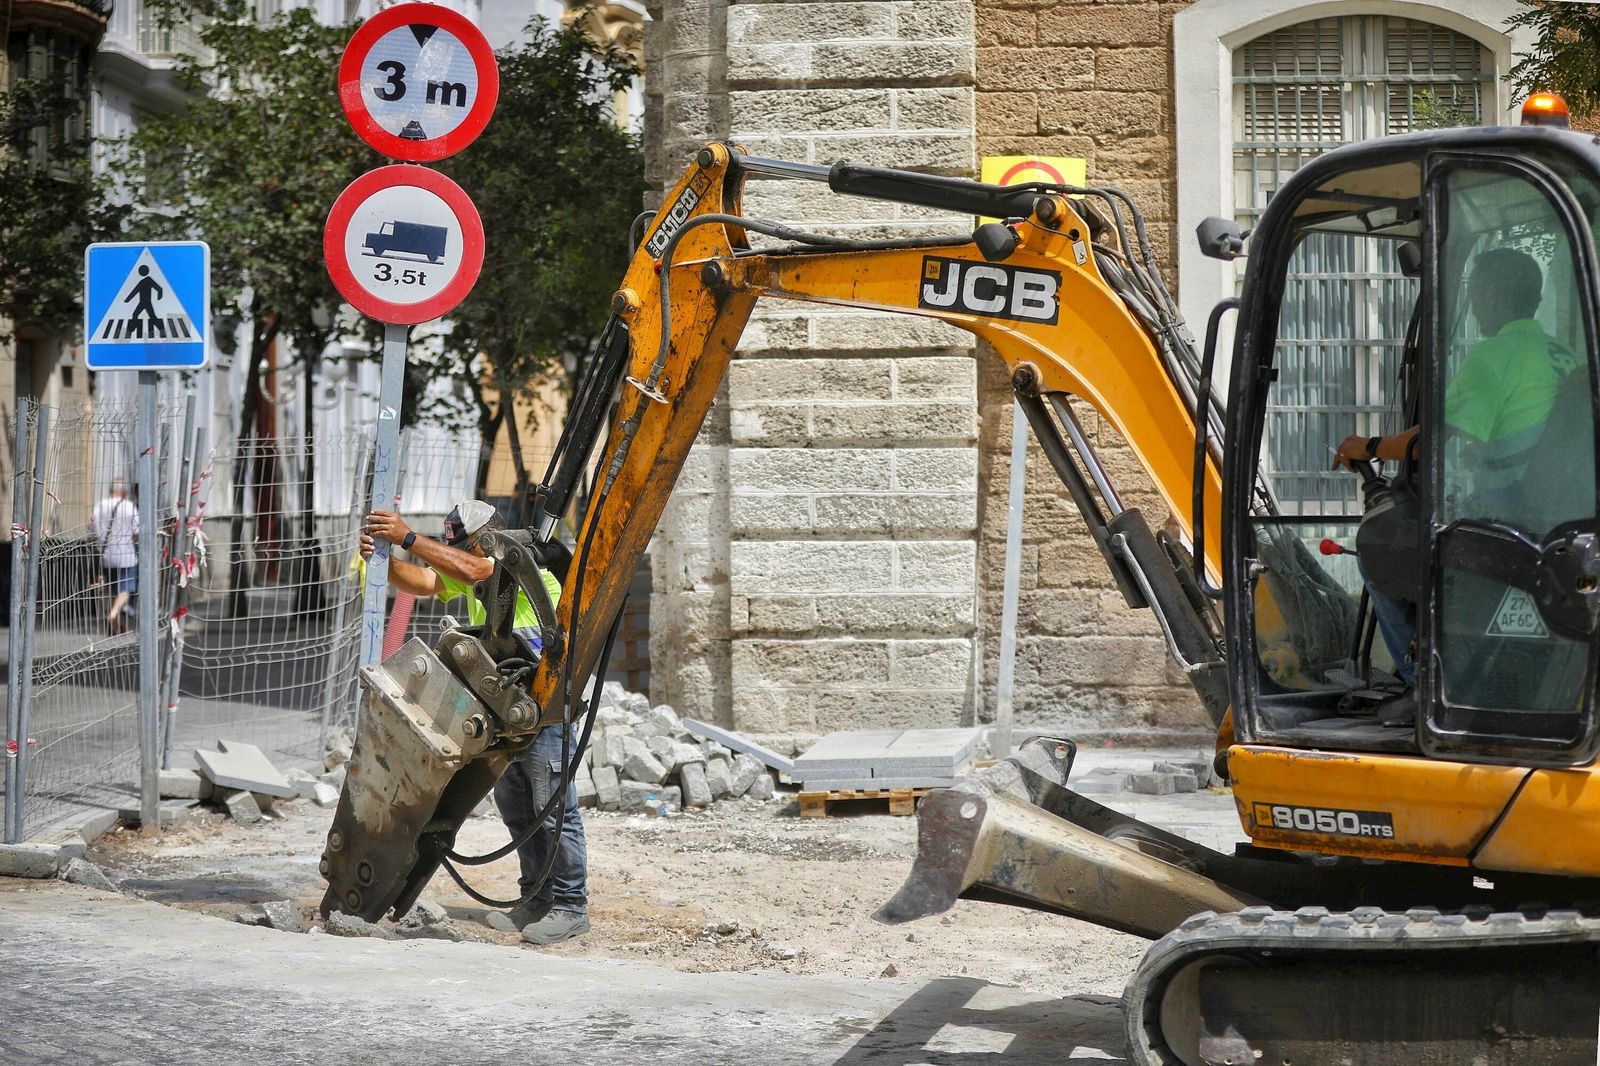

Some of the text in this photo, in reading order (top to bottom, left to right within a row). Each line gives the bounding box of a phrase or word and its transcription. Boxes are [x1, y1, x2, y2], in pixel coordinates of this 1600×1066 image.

[374, 61, 467, 107] 3 m
[373, 263, 427, 286] 3,5t
[923, 262, 1057, 320] JCB
